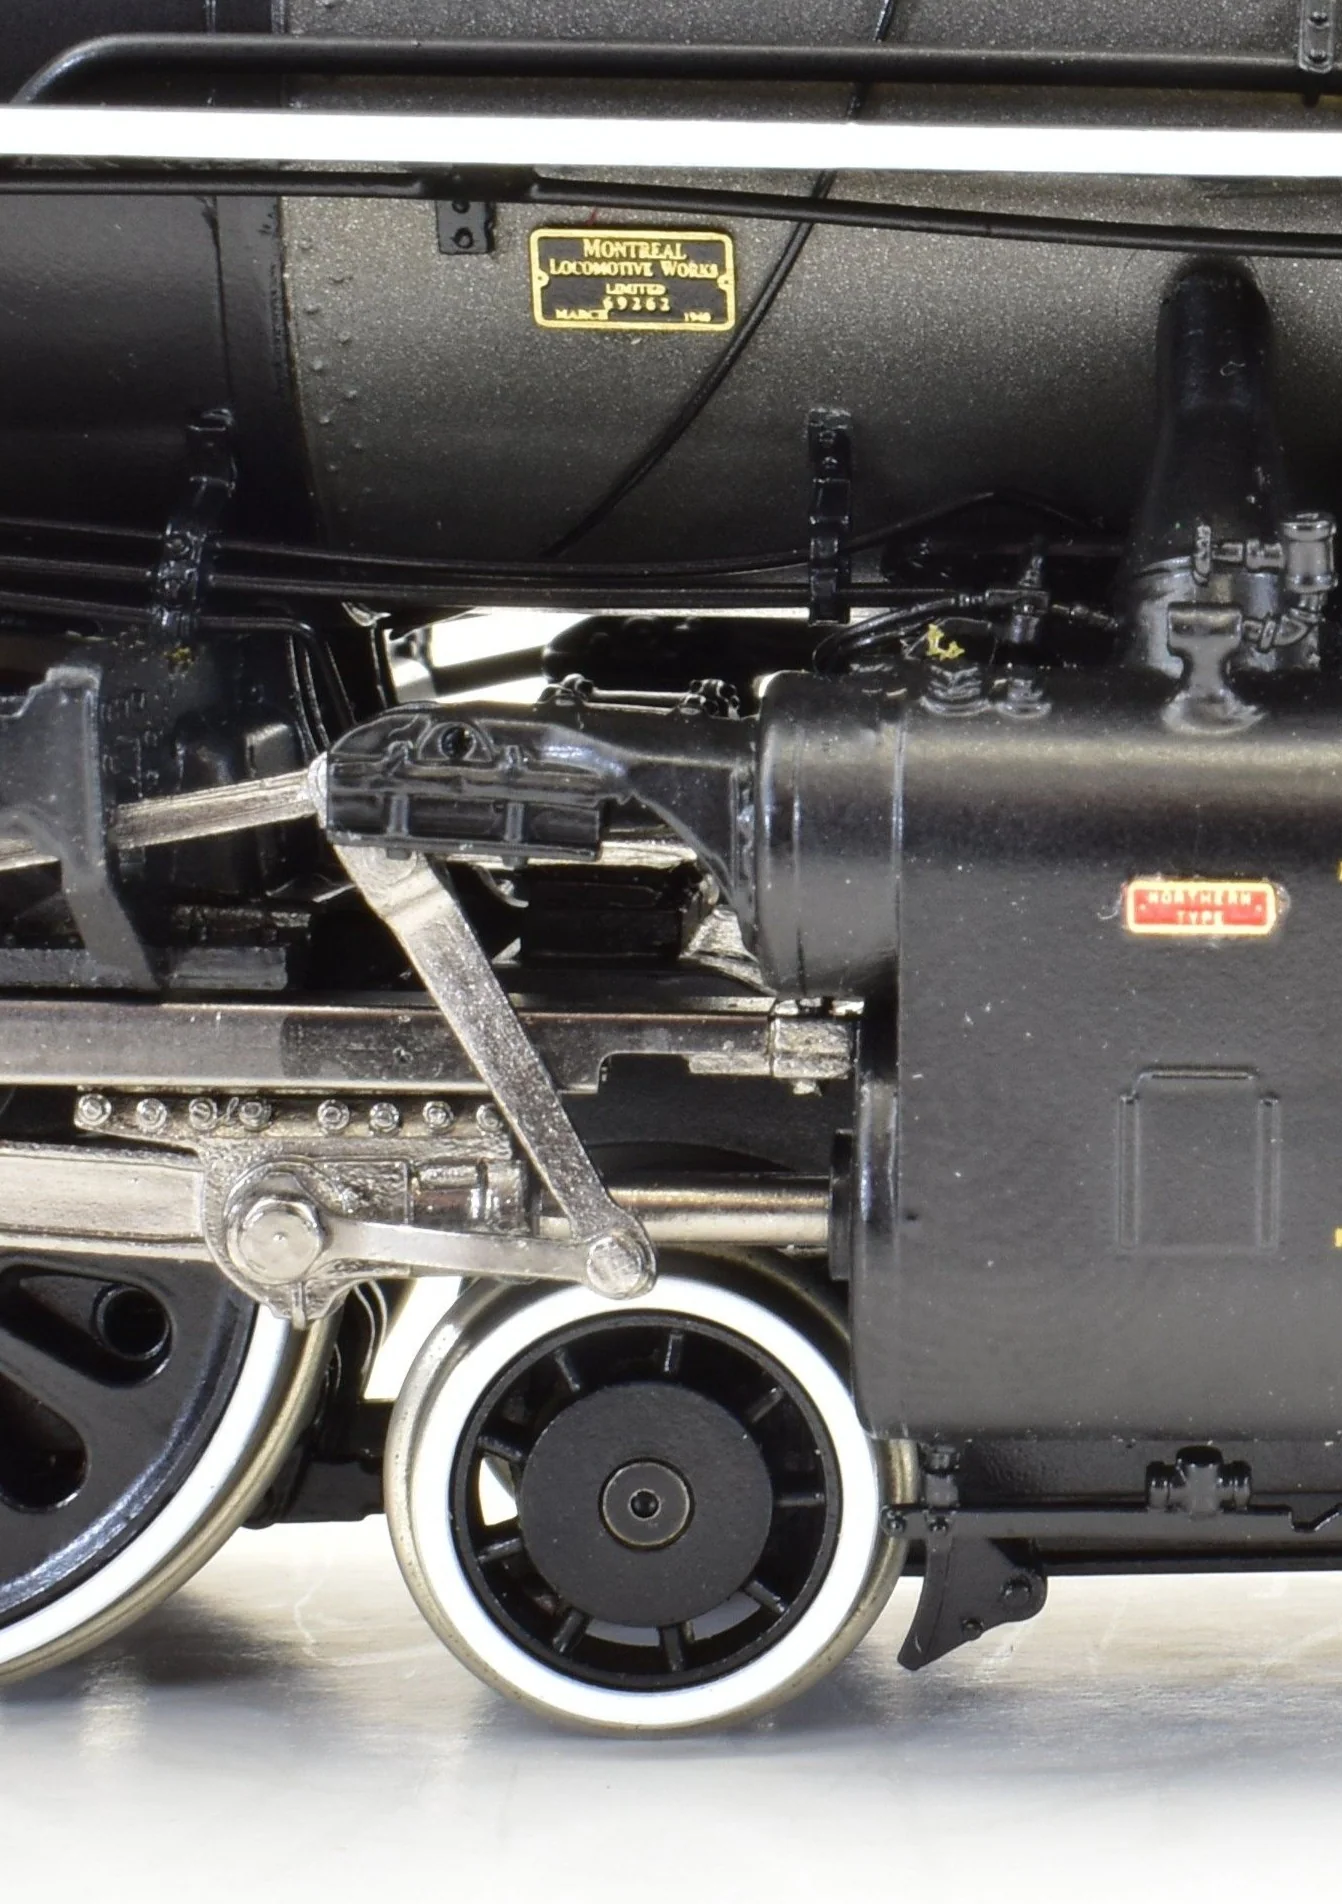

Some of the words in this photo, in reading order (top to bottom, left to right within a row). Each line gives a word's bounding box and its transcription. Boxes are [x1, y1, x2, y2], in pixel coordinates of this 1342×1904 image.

[582, 238, 687, 260] MONTREAL
[549, 258, 653, 277] LOCOMOTIVE
[660, 261, 719, 279] WORKS
